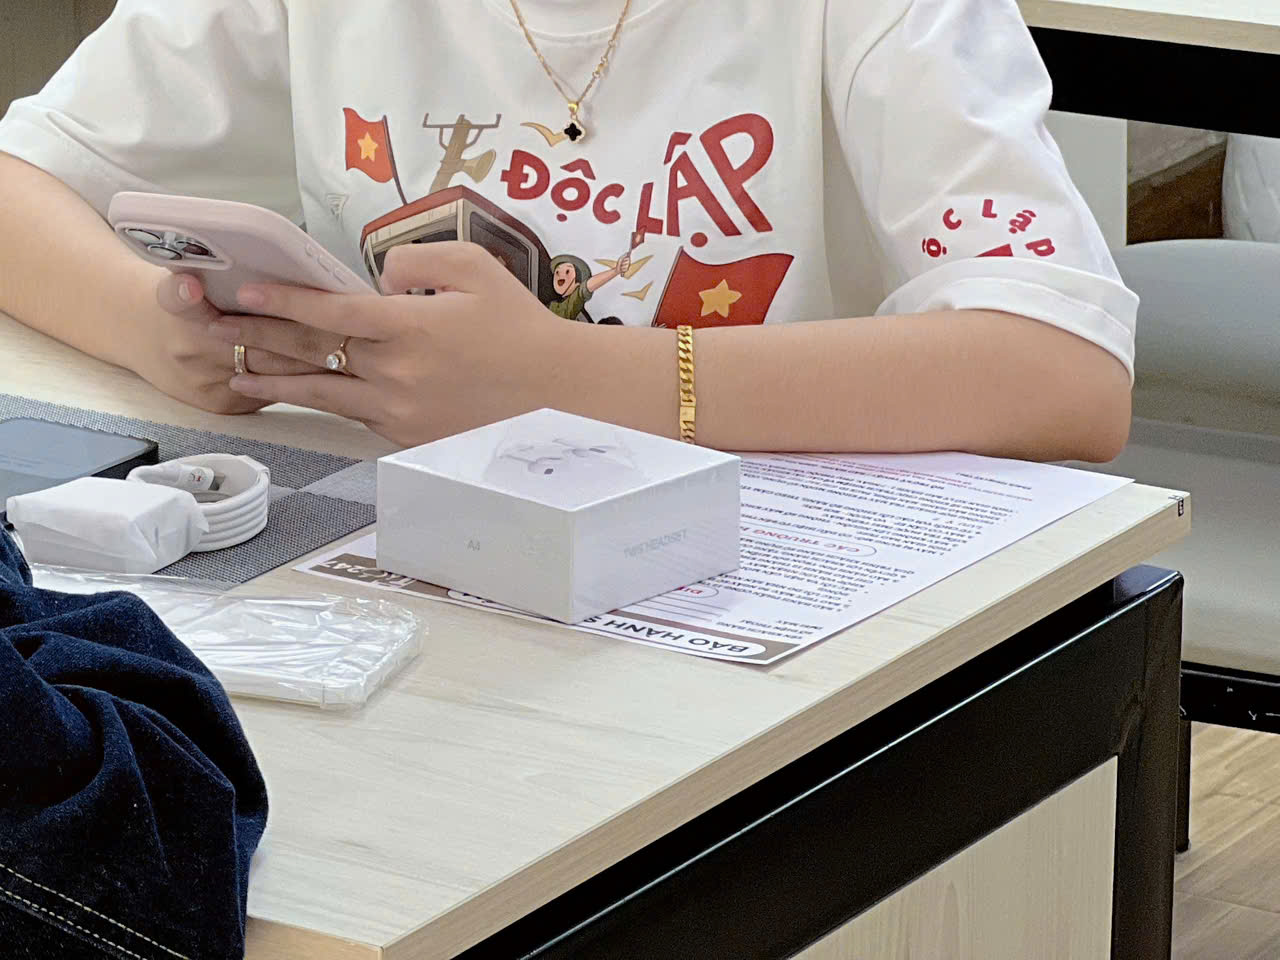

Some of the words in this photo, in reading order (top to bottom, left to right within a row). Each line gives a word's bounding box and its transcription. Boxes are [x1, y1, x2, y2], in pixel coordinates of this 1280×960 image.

[500, 149, 625, 225] ĐỘC
[602, 619, 685, 640] HÀNH
[684, 637, 748, 654] BẢO
